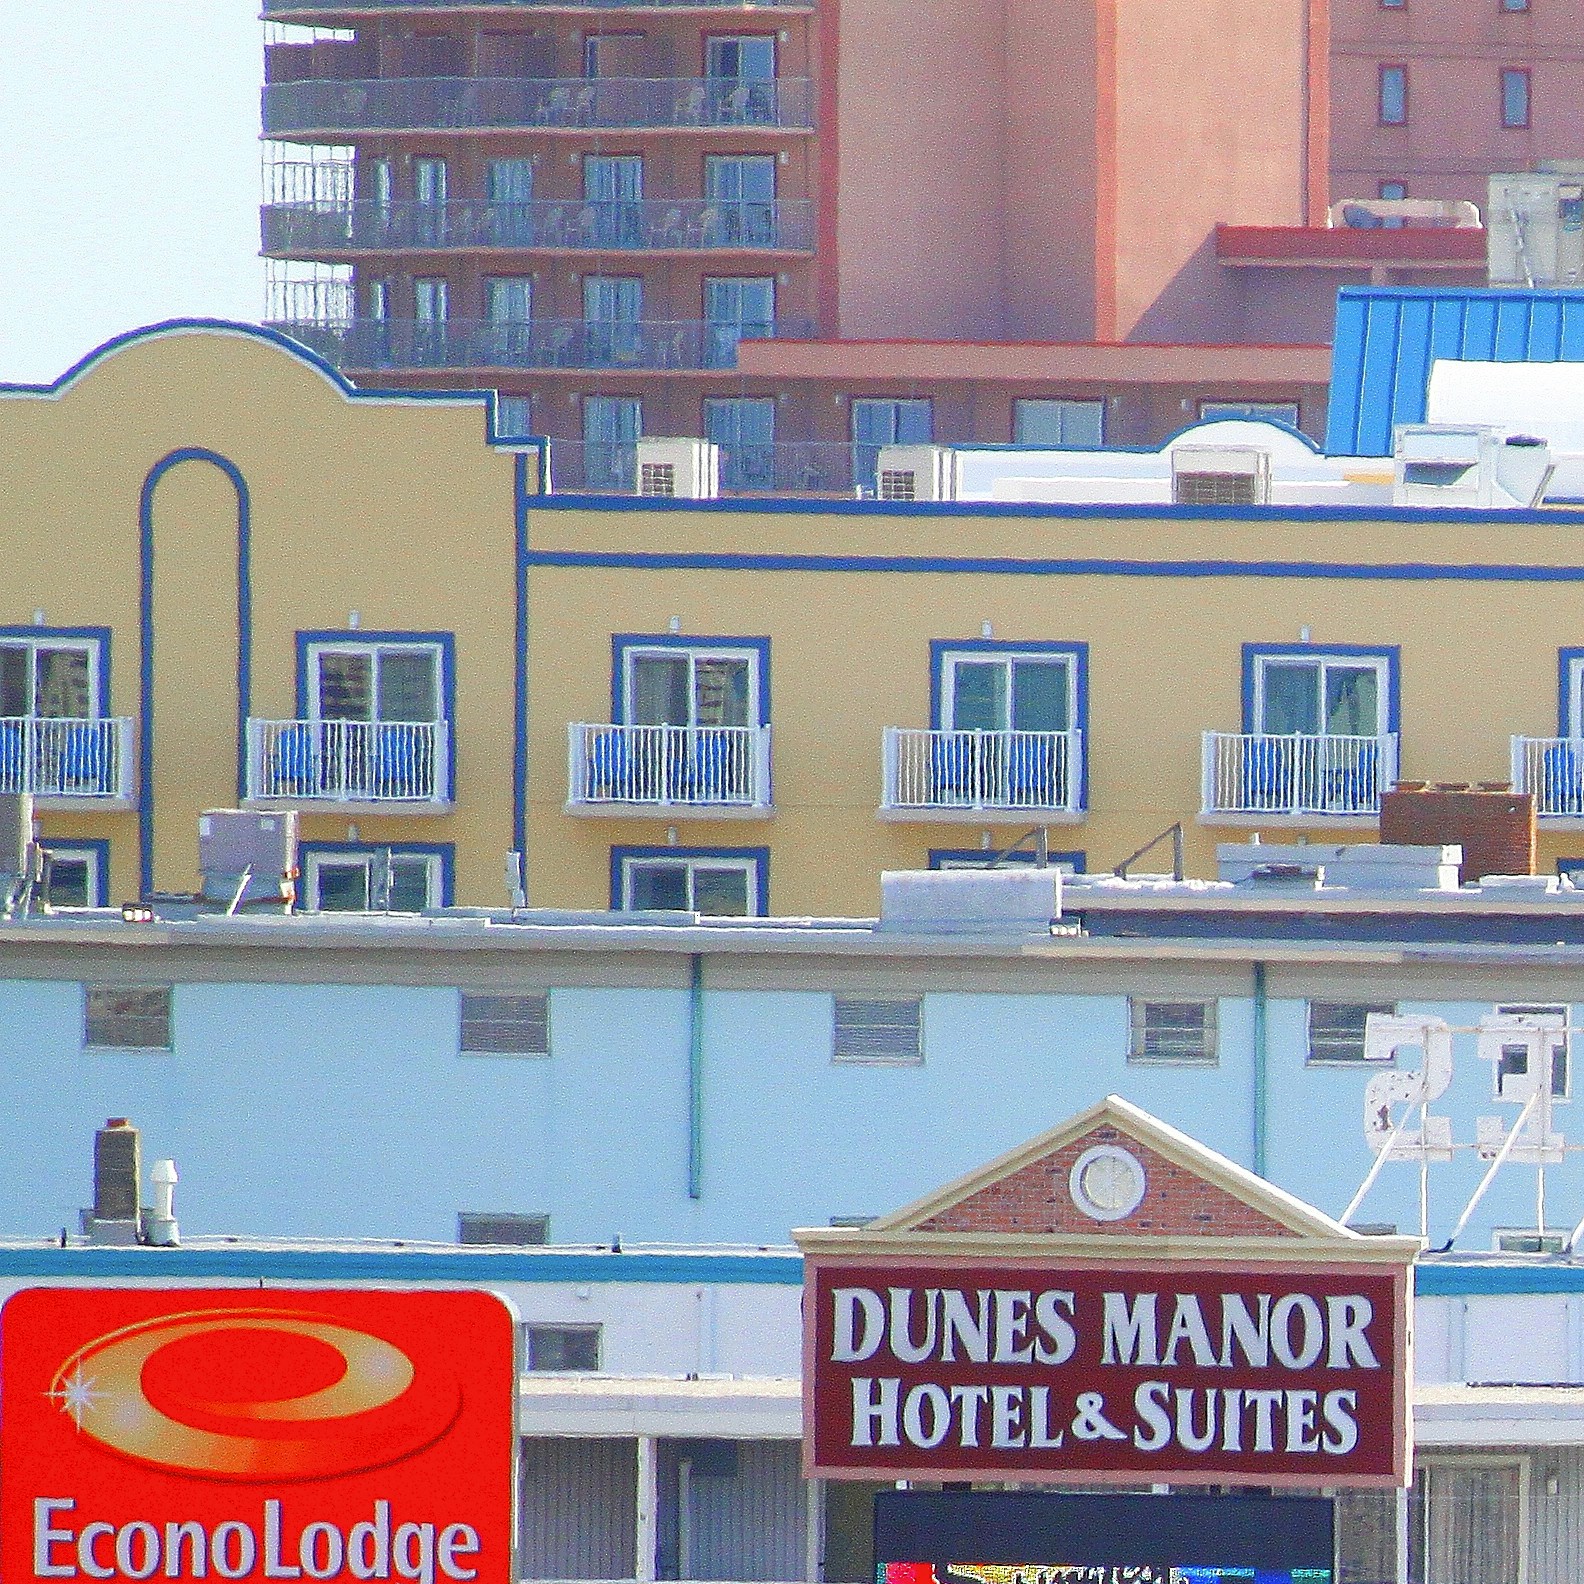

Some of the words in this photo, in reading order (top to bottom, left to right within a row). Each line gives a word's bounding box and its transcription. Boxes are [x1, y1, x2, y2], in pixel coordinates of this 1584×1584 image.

[831, 1287, 1077, 1366] DUNES
[1100, 1293, 1381, 1370] MANOR
[851, 1376, 1064, 1450] HOTEL
[1071, 1391, 1128, 1440] &
[1132, 1379, 1360, 1456] SUITES
